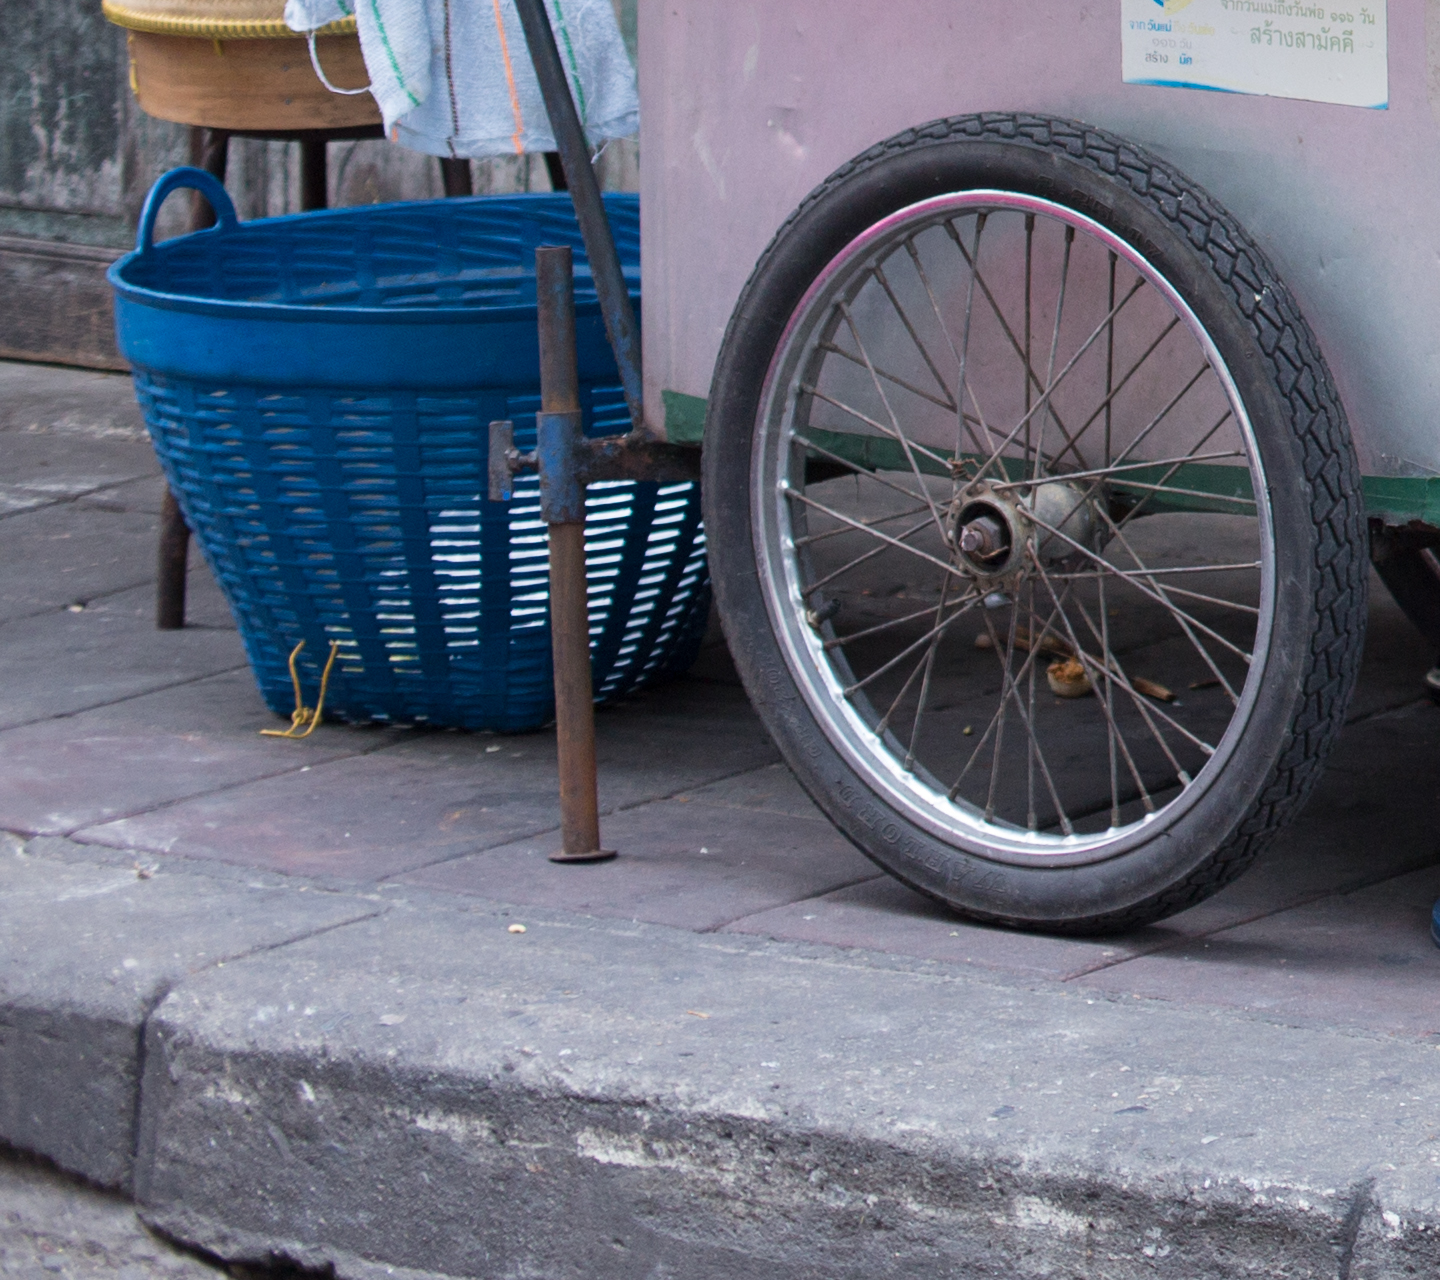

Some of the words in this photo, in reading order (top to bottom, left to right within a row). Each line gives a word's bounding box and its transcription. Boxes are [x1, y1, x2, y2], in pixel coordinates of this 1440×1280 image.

[1359, 8, 1376, 25] วัน
[1249, 20, 1355, 53] สร้างสามัคคี
